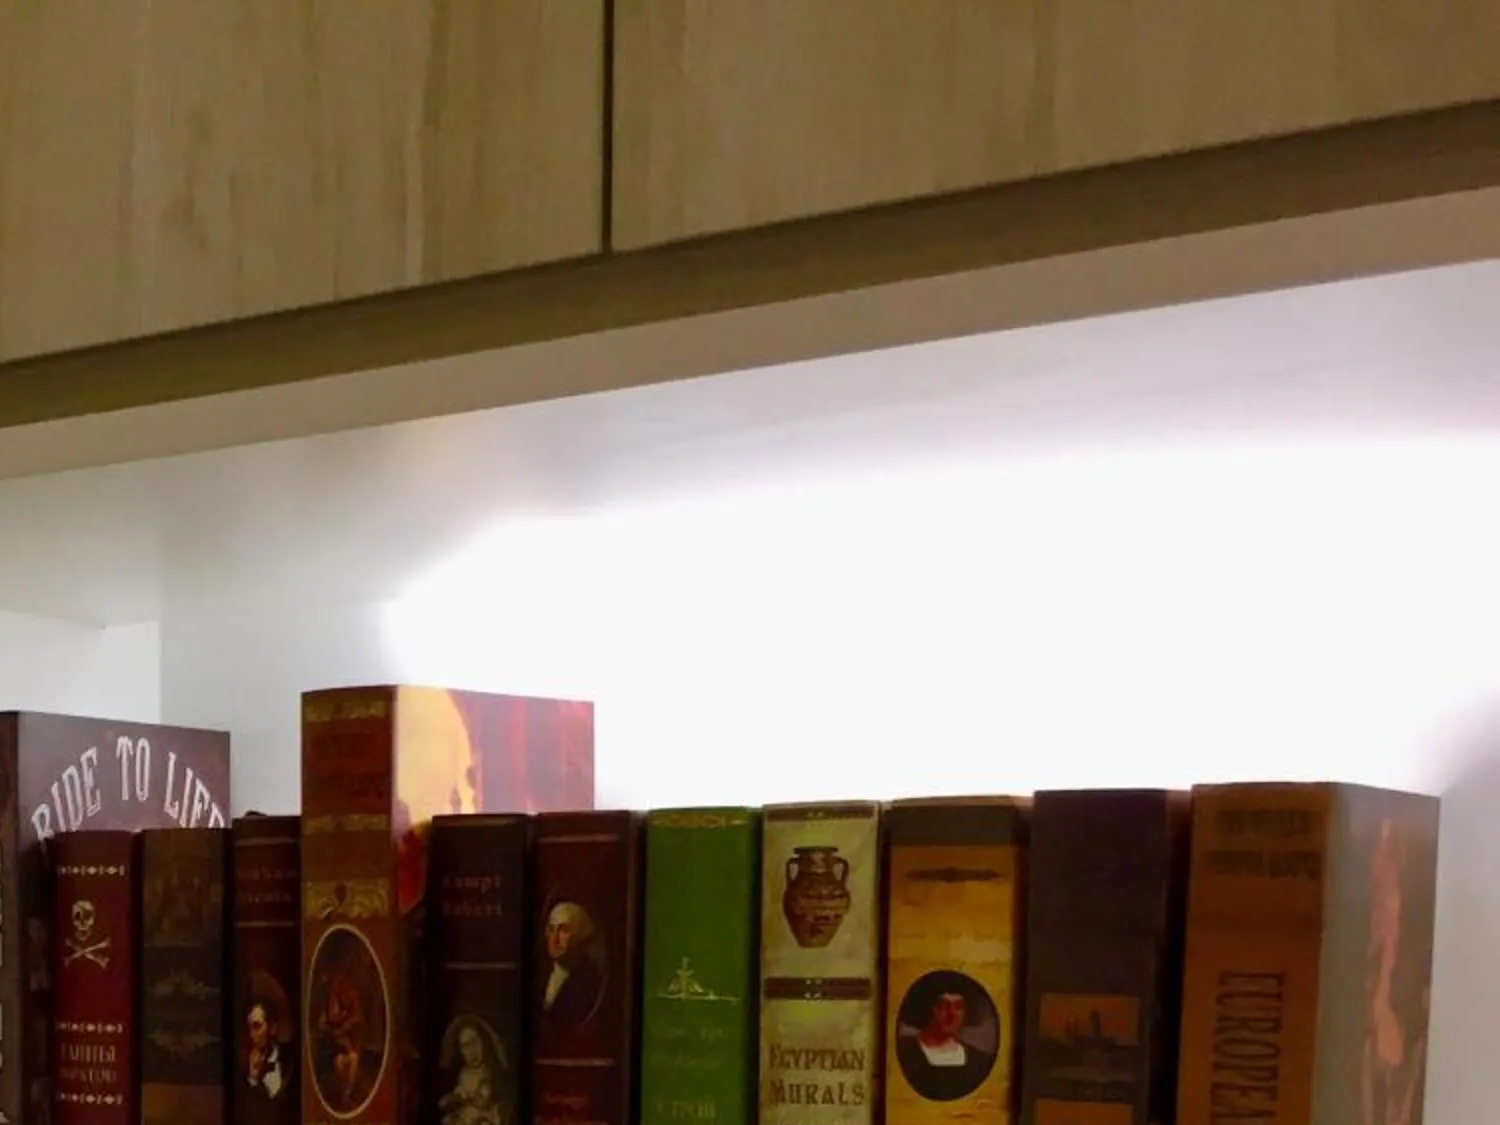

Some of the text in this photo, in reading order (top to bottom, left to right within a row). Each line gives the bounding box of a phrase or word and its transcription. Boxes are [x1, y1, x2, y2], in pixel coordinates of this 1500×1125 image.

[31, 746, 101, 841] RIDE
[116, 736, 151, 802] TO
[768, 1043, 866, 1072] EGYPTIAN
[769, 1078, 866, 1106] MURALS
